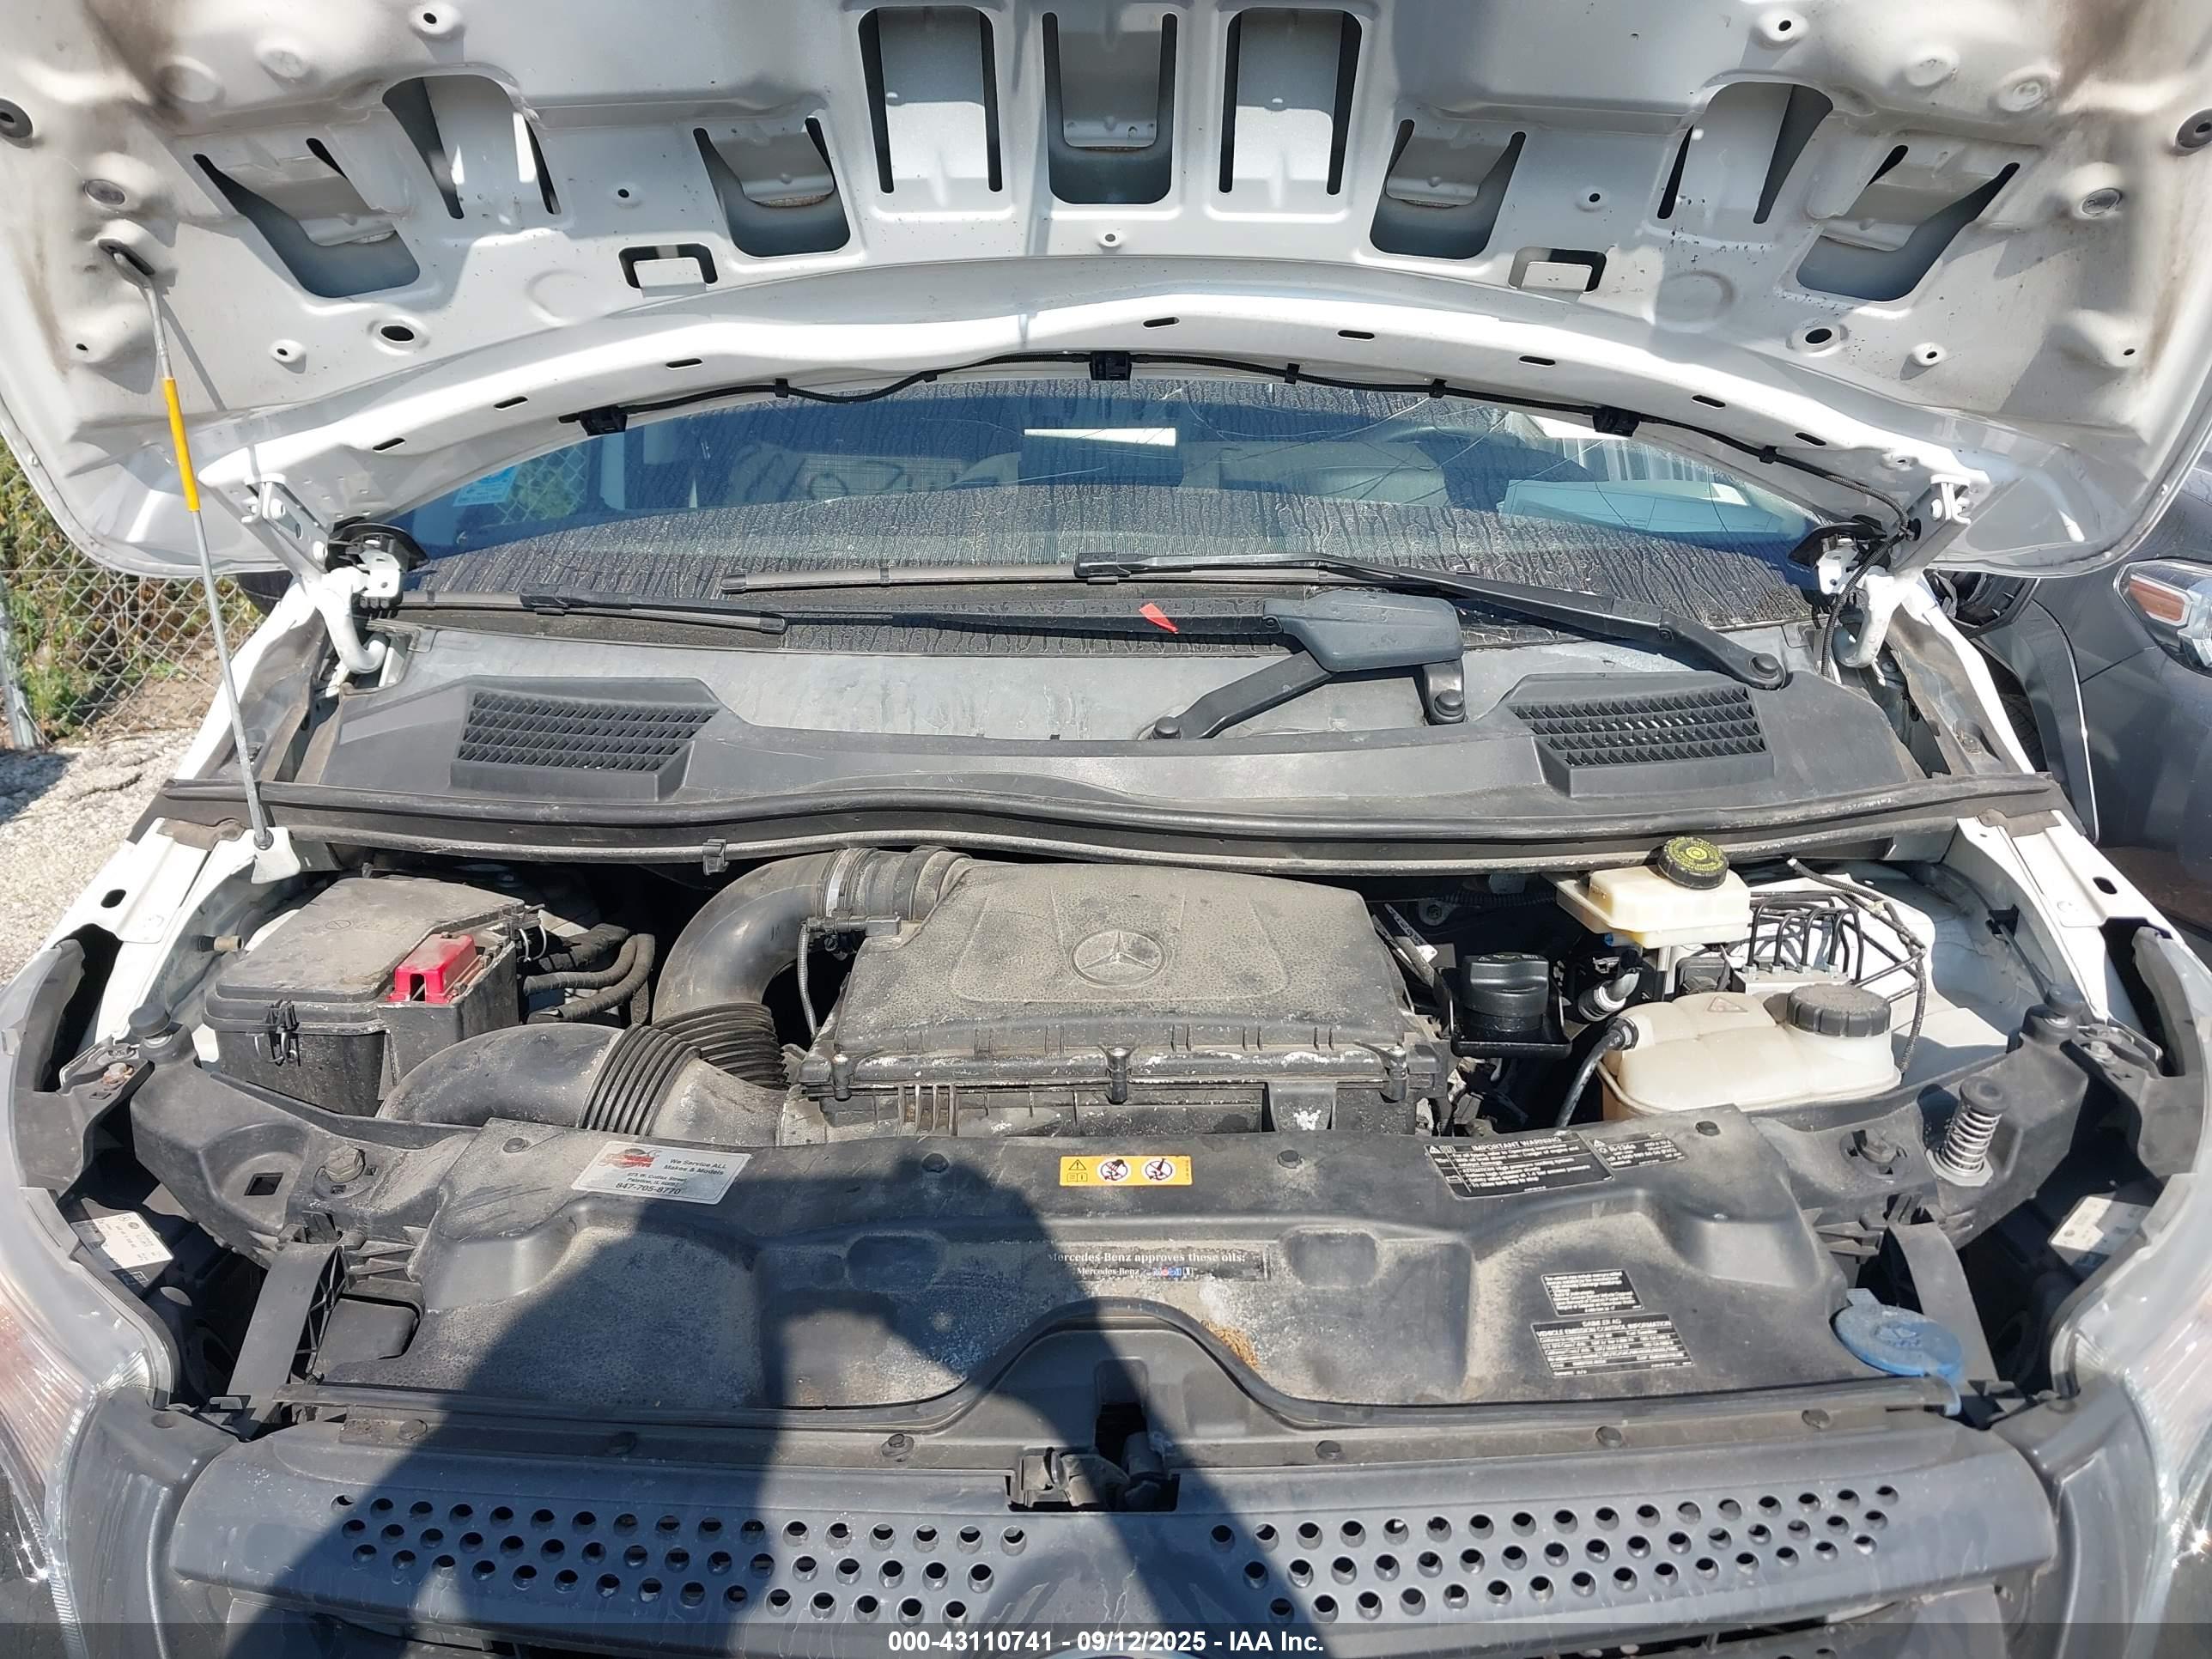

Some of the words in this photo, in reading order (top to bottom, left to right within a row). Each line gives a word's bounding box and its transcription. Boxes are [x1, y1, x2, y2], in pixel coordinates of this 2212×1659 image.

[1470, 1141, 1520, 1151] IMPORTANT
[1519, 1136, 1563, 1146] WARNING
[614, 1182, 681, 1194] 847-705-8770
[1133, 1251, 1186, 1266] approves
[1188, 1251, 1219, 1262] these
[1077, 1267, 1140, 1276] Mercedes-Benz
[1595, 1323, 1626, 1332] CONTROL
[1626, 1320, 1672, 1328] INFORMATION
